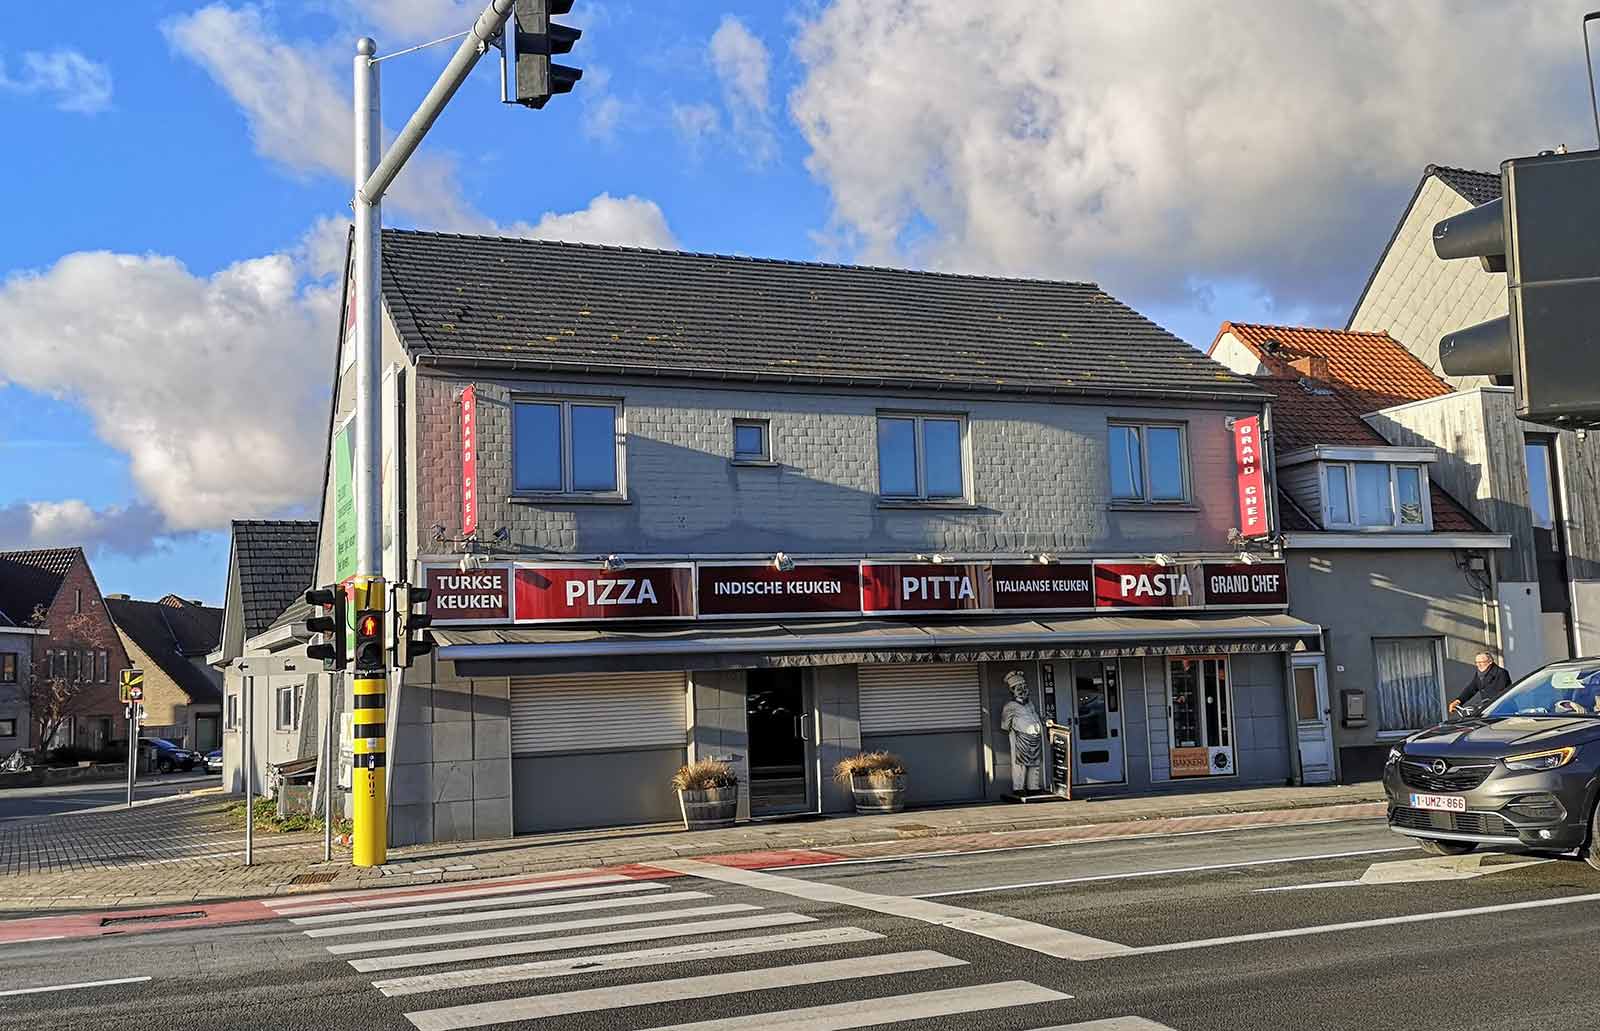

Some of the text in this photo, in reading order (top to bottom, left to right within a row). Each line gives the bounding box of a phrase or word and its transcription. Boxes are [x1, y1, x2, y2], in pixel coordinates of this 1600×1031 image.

[1245, 486, 1258, 526] CHEF
[437, 575, 502, 590] TURKSE
[714, 580, 842, 596] INDISCHE KEUKEN
[903, 575, 975, 600] PITTA
[996, 578, 1089, 593] ITALIAANSE KEUKEN
[1120, 573, 1192, 598] PASTA
[1210, 574, 1280, 594] GRAND CHEF
[565, 578, 658, 606] PIZZA
[437, 594, 503, 610] KEUKEN
[1416, 796, 1464, 808] 1-UMZ-866
